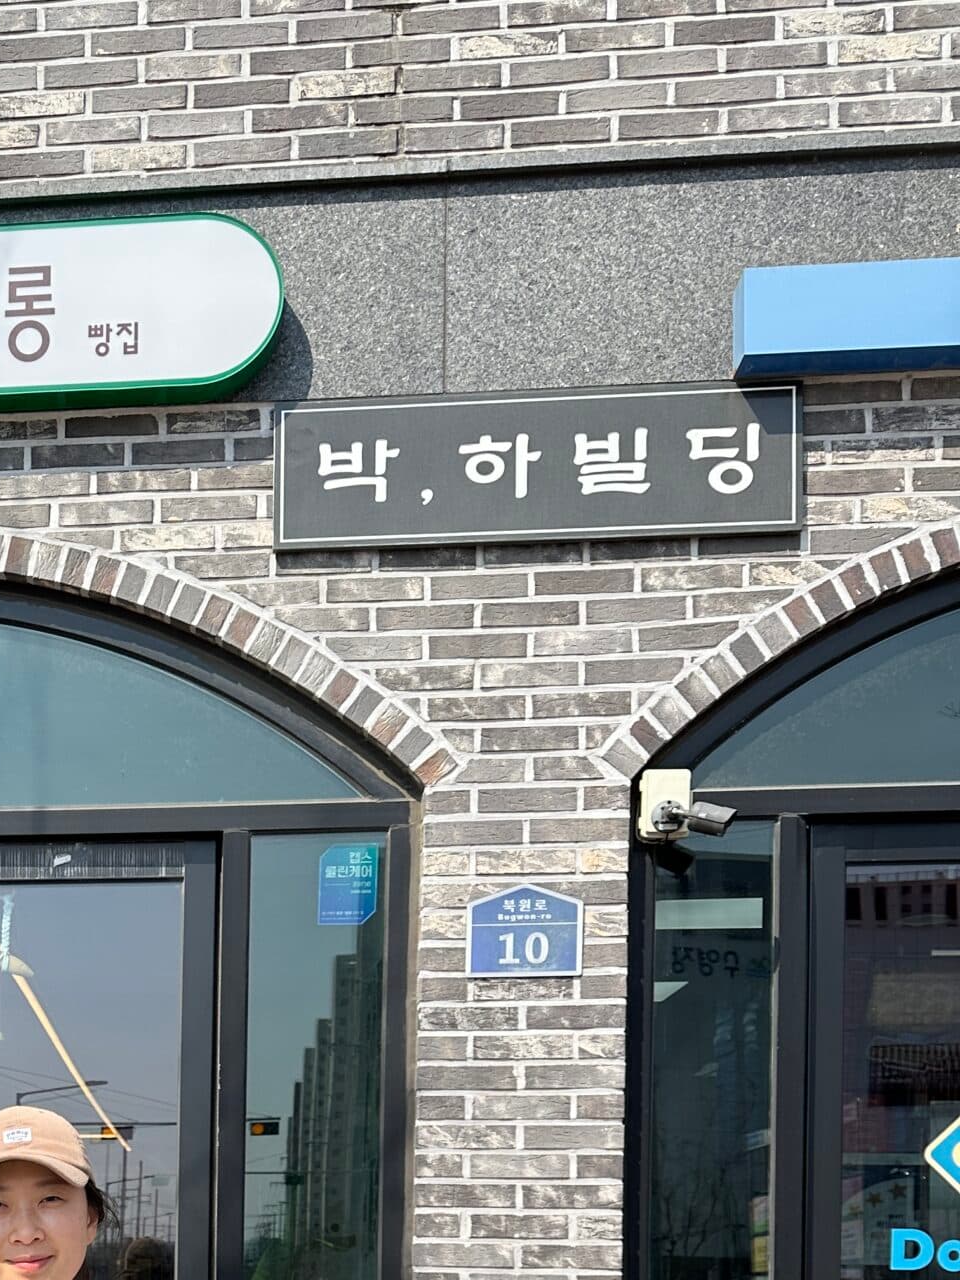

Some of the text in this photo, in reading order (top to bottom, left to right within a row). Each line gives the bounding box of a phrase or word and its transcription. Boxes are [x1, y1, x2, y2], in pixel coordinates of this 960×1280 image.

[88, 322, 139, 357] 빵집
[349, 851, 372, 864] 캡스
[502, 899, 548, 912] 북원로
[497, 913, 552, 922] Bugwon-ro
[498, 931, 549, 965] 10
